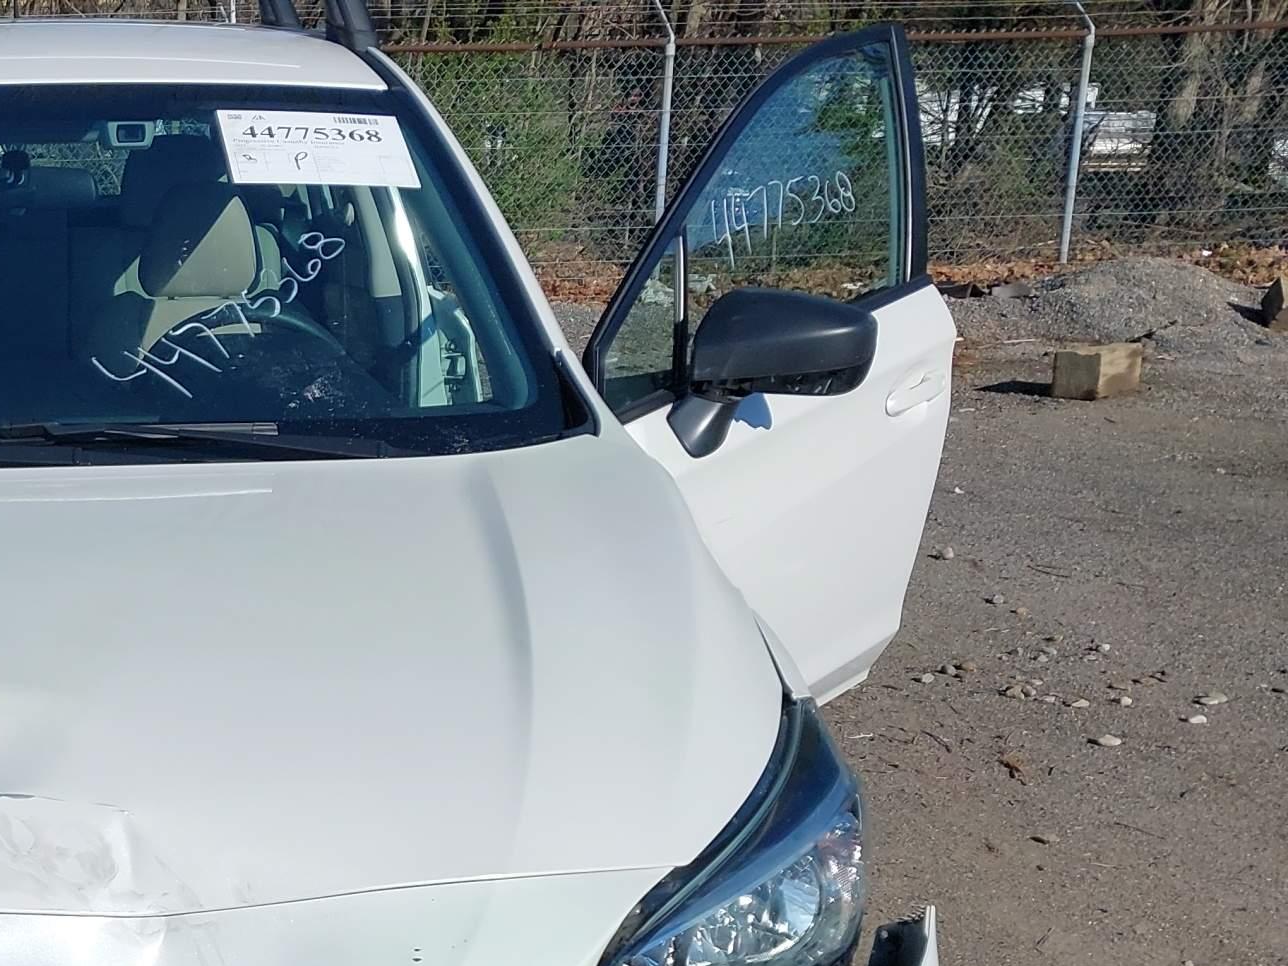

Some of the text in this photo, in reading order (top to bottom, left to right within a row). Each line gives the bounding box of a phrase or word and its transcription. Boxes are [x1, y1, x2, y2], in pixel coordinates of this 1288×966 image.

[242, 126, 383, 143] 44775368
[711, 171, 856, 270] 44775368
[91, 231, 346, 399] 44775368
